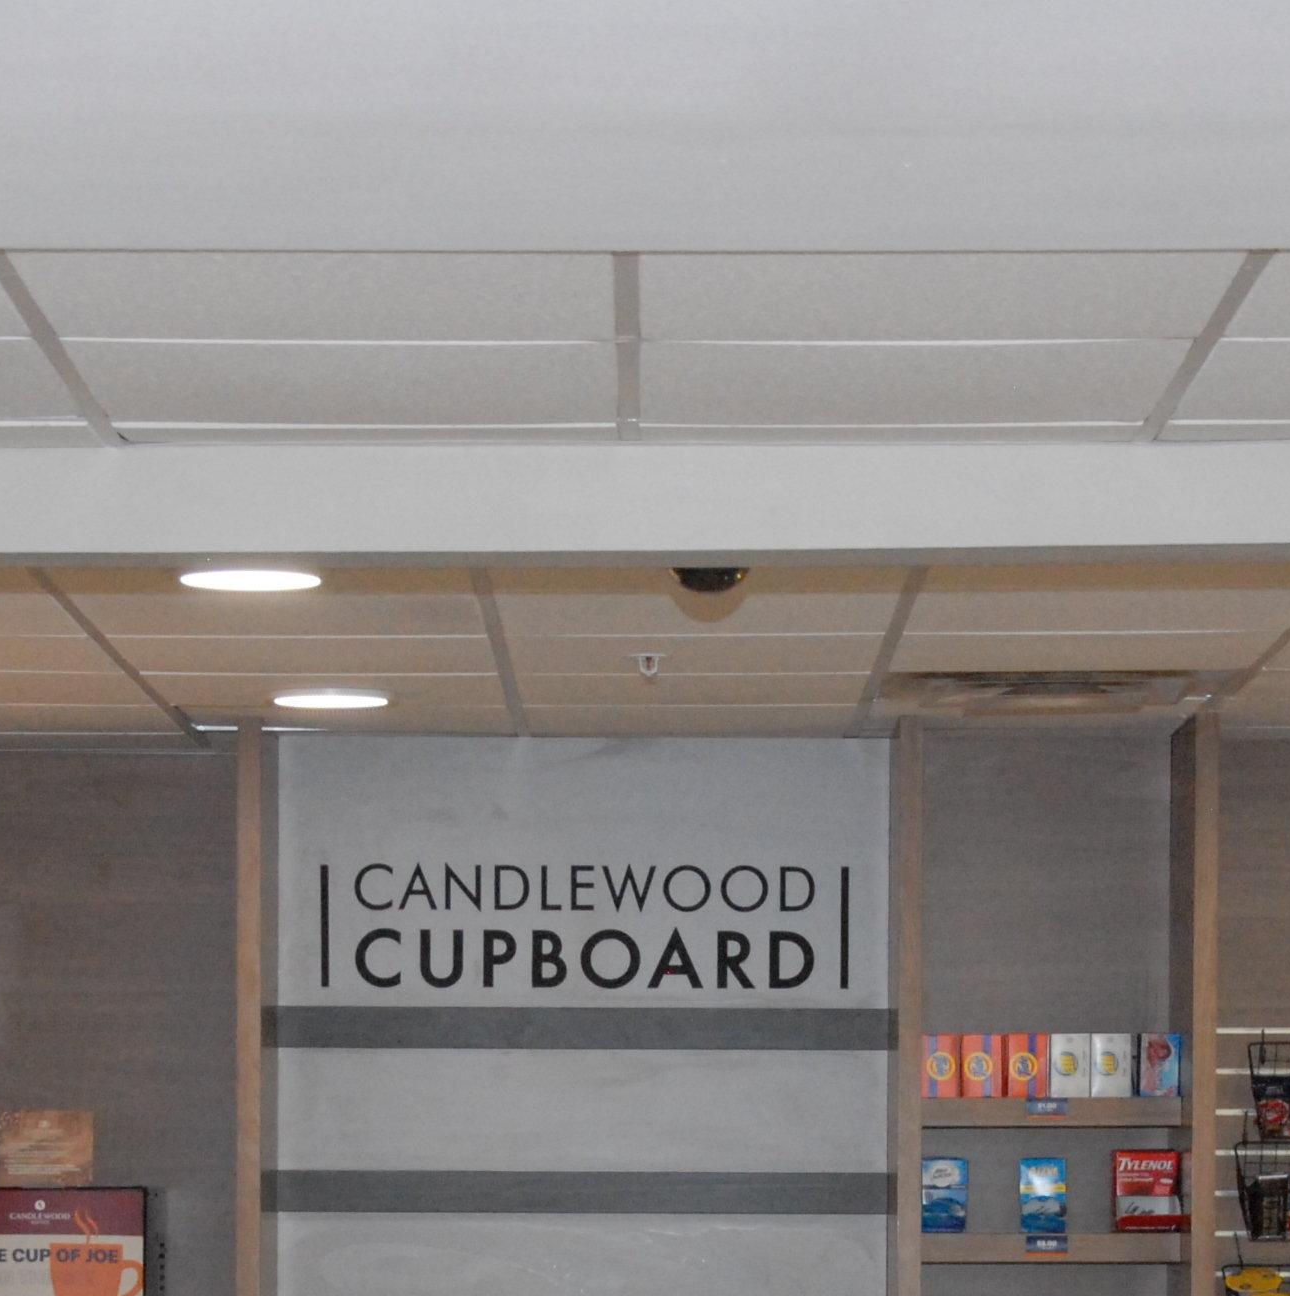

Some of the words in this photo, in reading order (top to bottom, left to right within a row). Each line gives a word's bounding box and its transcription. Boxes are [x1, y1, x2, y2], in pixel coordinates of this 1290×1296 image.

[353, 862, 815, 912] CANDLEWOOD
[354, 927, 815, 989] CUPBOARD
[1117, 1157, 1174, 1172] TYLENOL
[9, 1212, 71, 1220] CANDLEWOOD
[12, 1248, 50, 1263] CUP
[56, 1249, 81, 1263] OF
[85, 1249, 118, 1263] JOE
